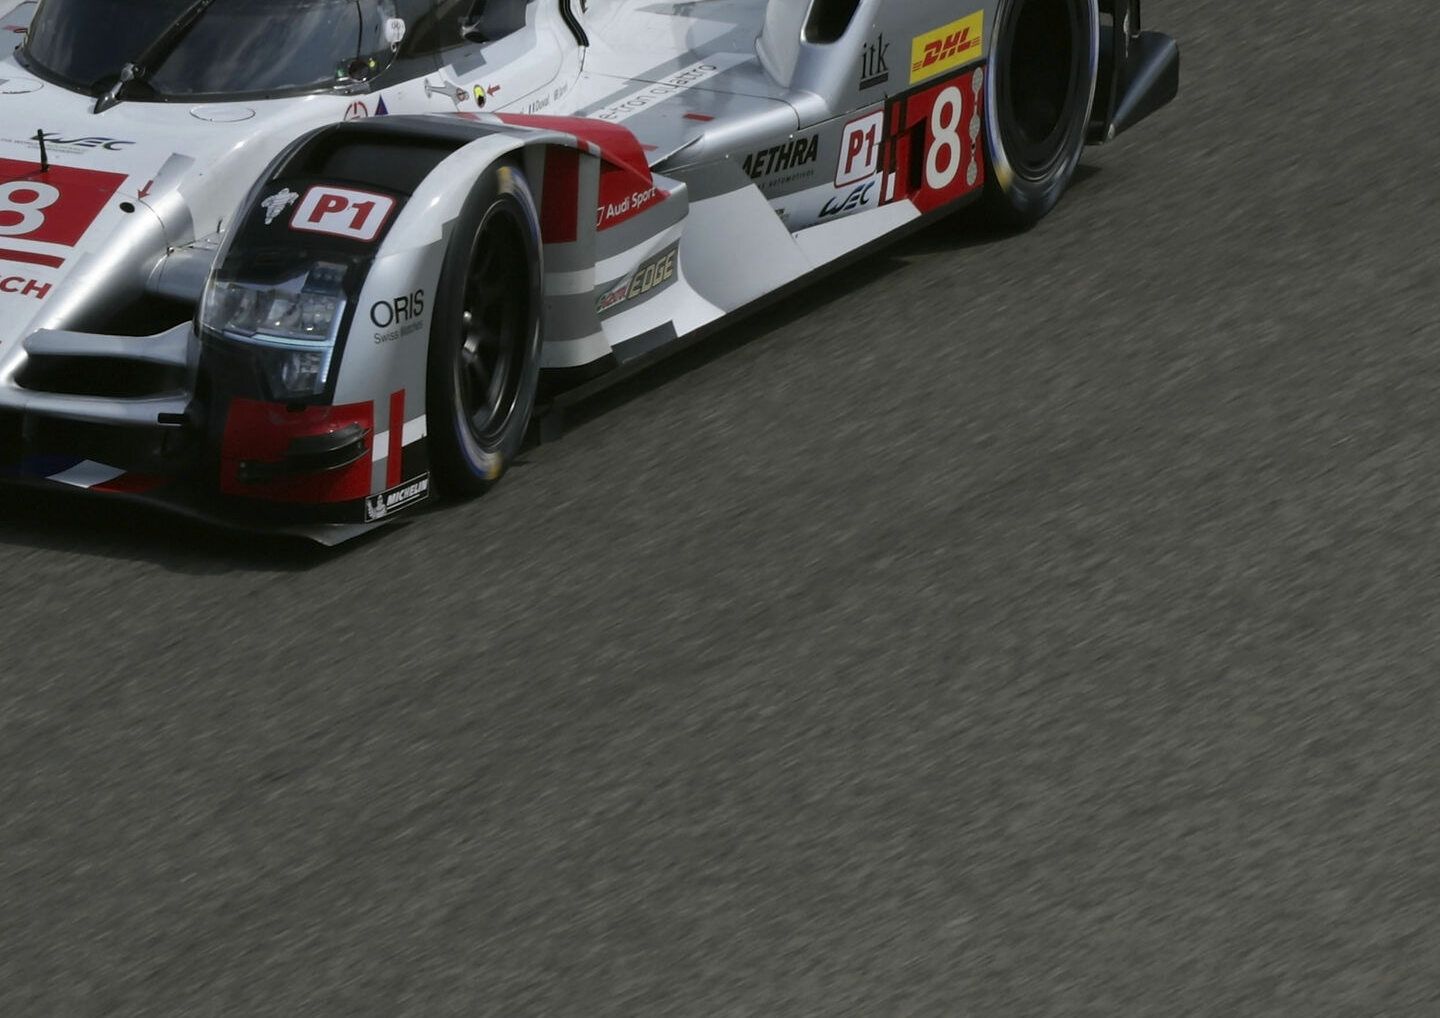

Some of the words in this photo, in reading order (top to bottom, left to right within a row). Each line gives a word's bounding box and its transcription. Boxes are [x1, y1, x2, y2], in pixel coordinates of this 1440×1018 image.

[860, 32, 890, 79] itk
[922, 27, 972, 68] DHL
[742, 134, 818, 179] AETHRA
[844, 123, 876, 175] P1
[926, 86, 962, 190] 8
[307, 194, 376, 230] P1
[606, 195, 630, 219] Audi
[631, 186, 657, 209] Sport
[817, 180, 875, 218] WEC
[628, 250, 676, 298] EDGE
[370, 289, 424, 328] ORIS
